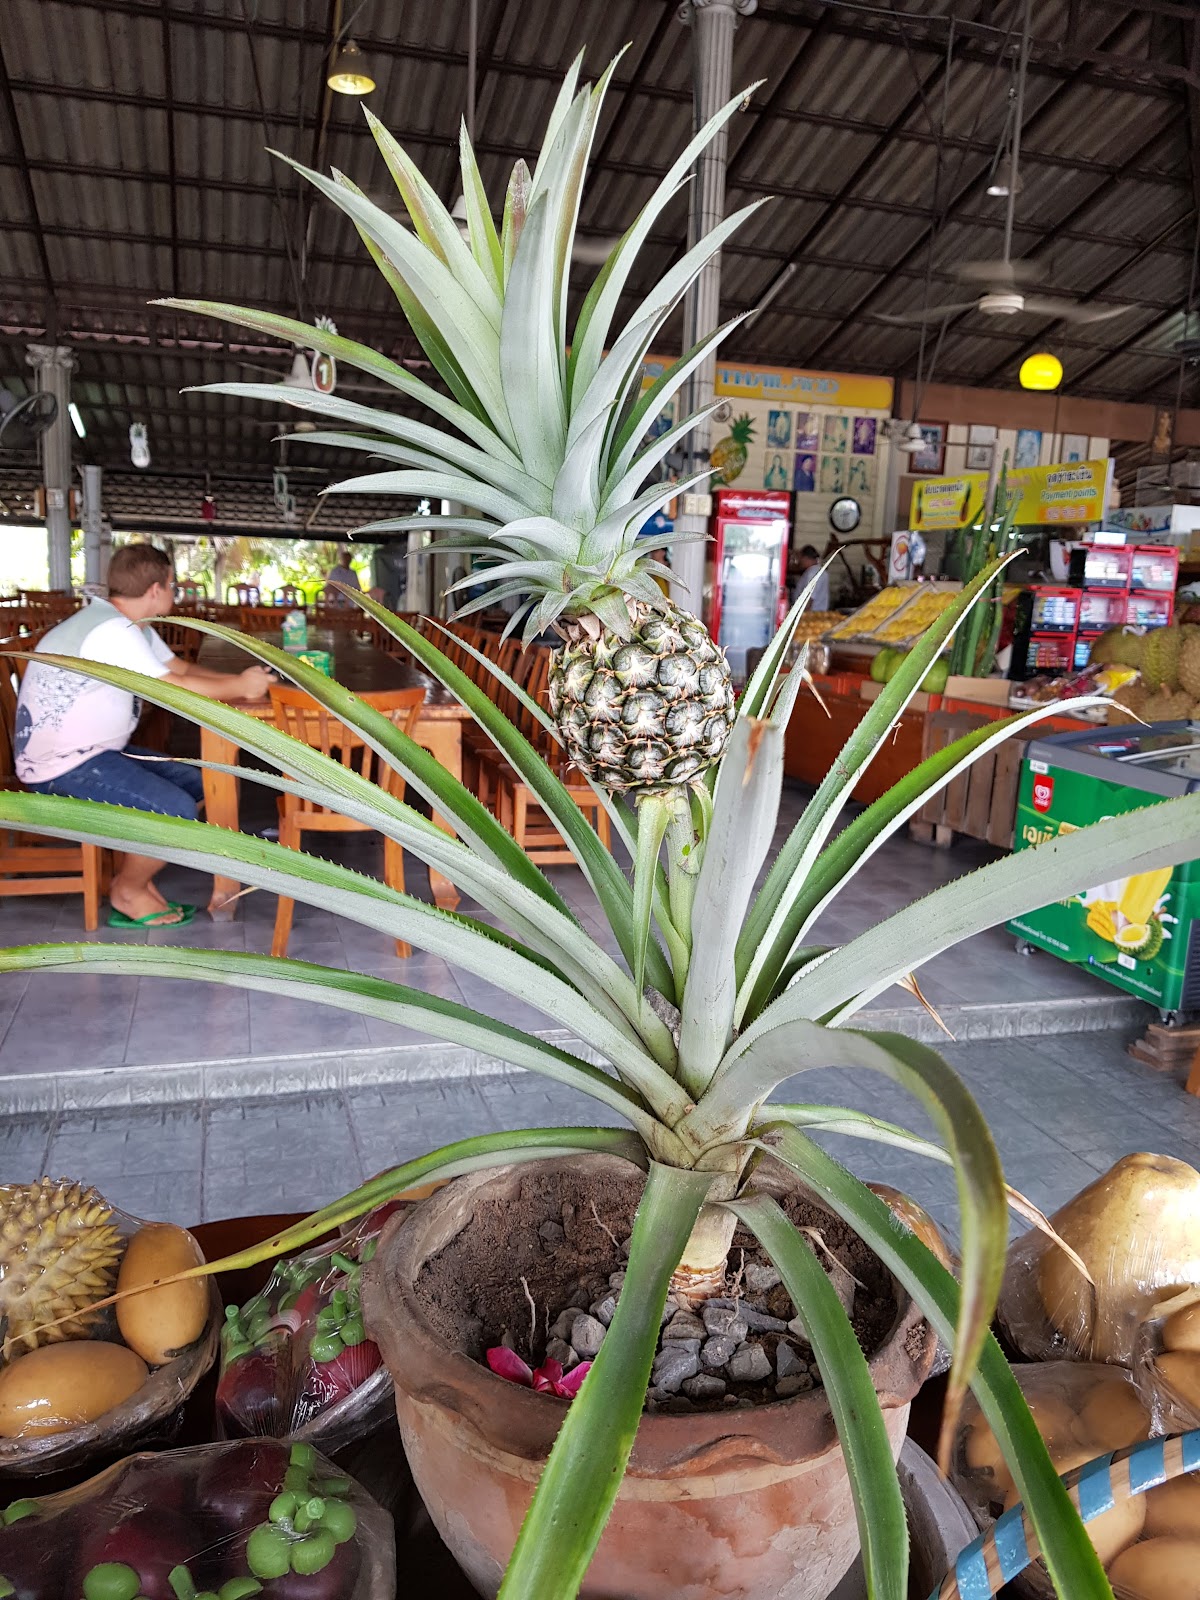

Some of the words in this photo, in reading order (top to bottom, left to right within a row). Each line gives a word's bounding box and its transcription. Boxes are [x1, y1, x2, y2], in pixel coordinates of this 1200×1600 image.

[319, 363, 328, 385] 1
[1040, 488, 1073, 502] Payment
[1073, 486, 1097, 502] points
